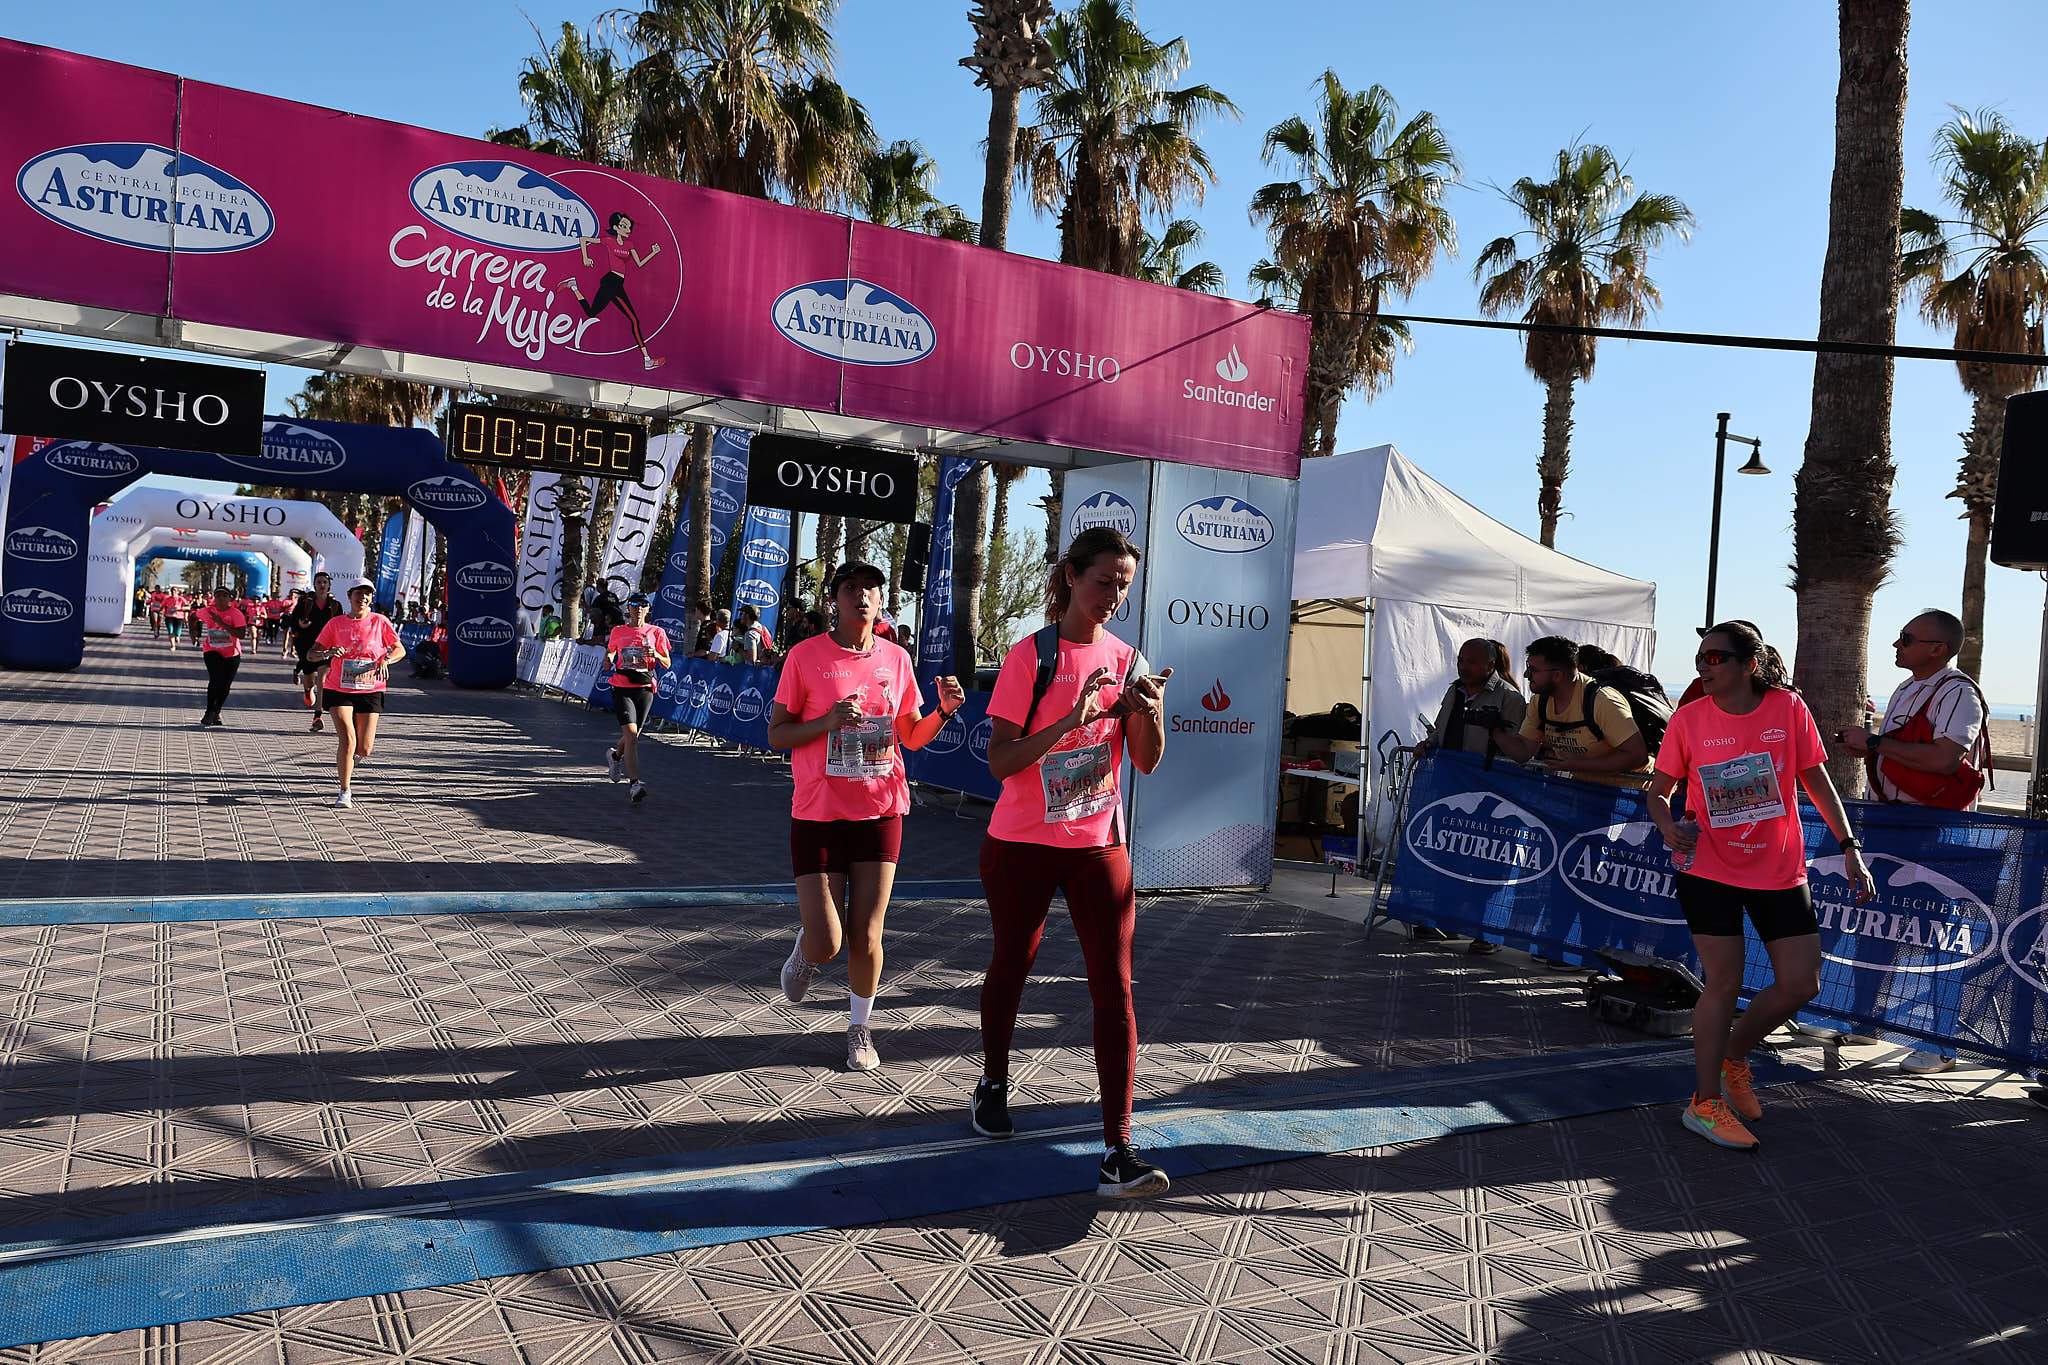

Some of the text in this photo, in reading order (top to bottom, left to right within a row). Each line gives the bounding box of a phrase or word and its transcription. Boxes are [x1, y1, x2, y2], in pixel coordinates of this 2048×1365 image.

[81, 169, 162, 192] CENTRAL
[37, 166, 255, 237] ASTURIANA
[424, 179, 583, 239] ASTURIANA
[456, 182, 580, 214] CENTRAL LECHERA
[389, 225, 547, 293] Carrera
[426, 278, 600, 361] de la Mujer
[784, 300, 923, 352] ASTURIANA
[812, 301, 920, 327] CENTRAL LECHERA
[1010, 342, 1121, 383] OYSHO
[49, 376, 229, 426] OYSHO
[1183, 378, 1276, 412] Santander
[262, 444, 336, 466] URIANA
[462, 413, 632, 470] 00:39:52
[51, 450, 132, 472] ASTURIANA
[777, 460, 895, 499] OYSHO
[413, 487, 482, 503] ASTURIANA
[105, 515, 143, 525] OYSHO
[176, 498, 287, 527] OYSHO
[314, 530, 348, 540] OYSHO
[605, 459, 666, 606] OYSHO
[1182, 513, 1267, 543] ASTURIANA
[7, 538, 73, 556] ASTURIANA
[88, 553, 122, 564] OYSHO
[520, 485, 559, 612] OYSHO
[3, 599, 69, 617] ASTURIANA
[1167, 599, 1269, 631] OYSHO
[1055, 673, 1077, 683] SHO
[1171, 714, 1256, 735] Santander
[1703, 737, 1736, 747] OYSHO
[1413, 815, 1542, 871] ASTURIANA
[1442, 816, 1543, 842] CENTRAL LECHERA
[1601, 846, 1660, 866] CENTRAL
[1568, 845, 1677, 899] ASTURI
[1891, 895, 1973, 919] LECHERA
